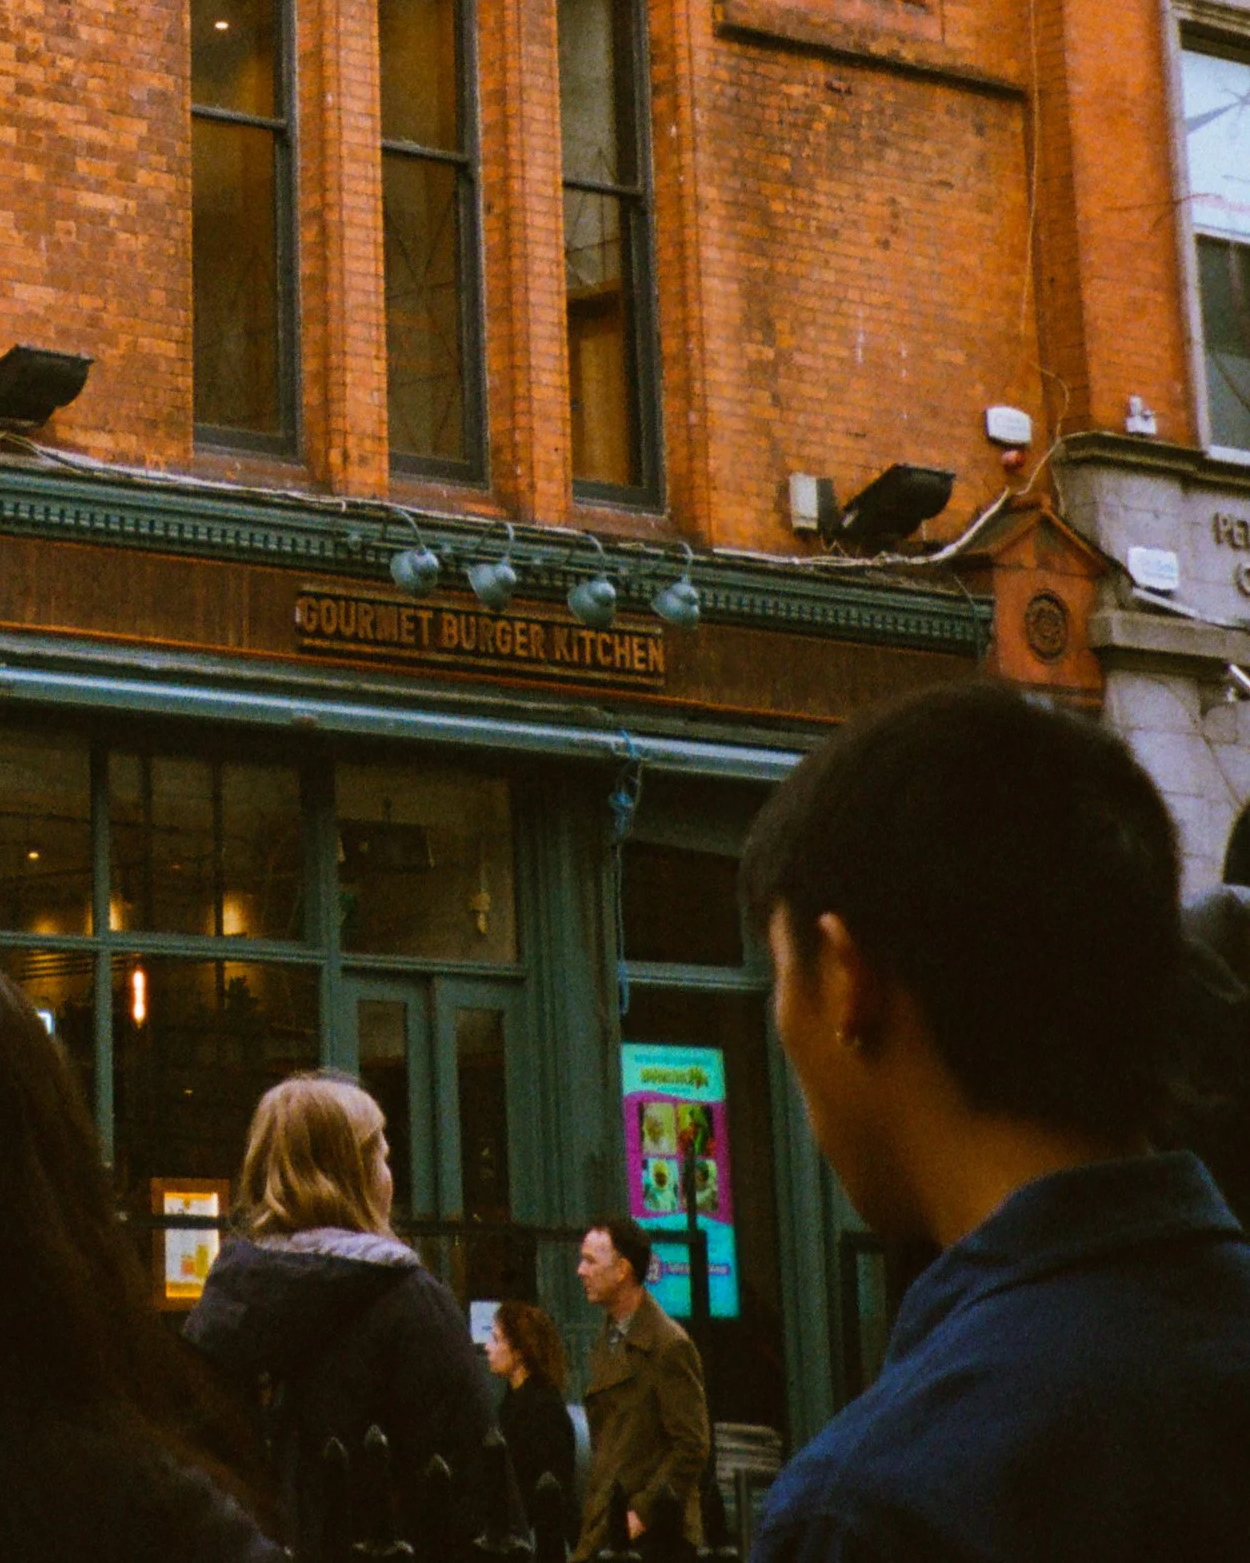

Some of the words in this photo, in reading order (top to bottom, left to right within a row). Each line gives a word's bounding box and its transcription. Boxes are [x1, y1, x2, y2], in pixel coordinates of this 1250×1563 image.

[300, 597, 434, 645] GOURMET
[440, 612, 546, 661] BURGER
[553, 629, 666, 674] KITCHEN
